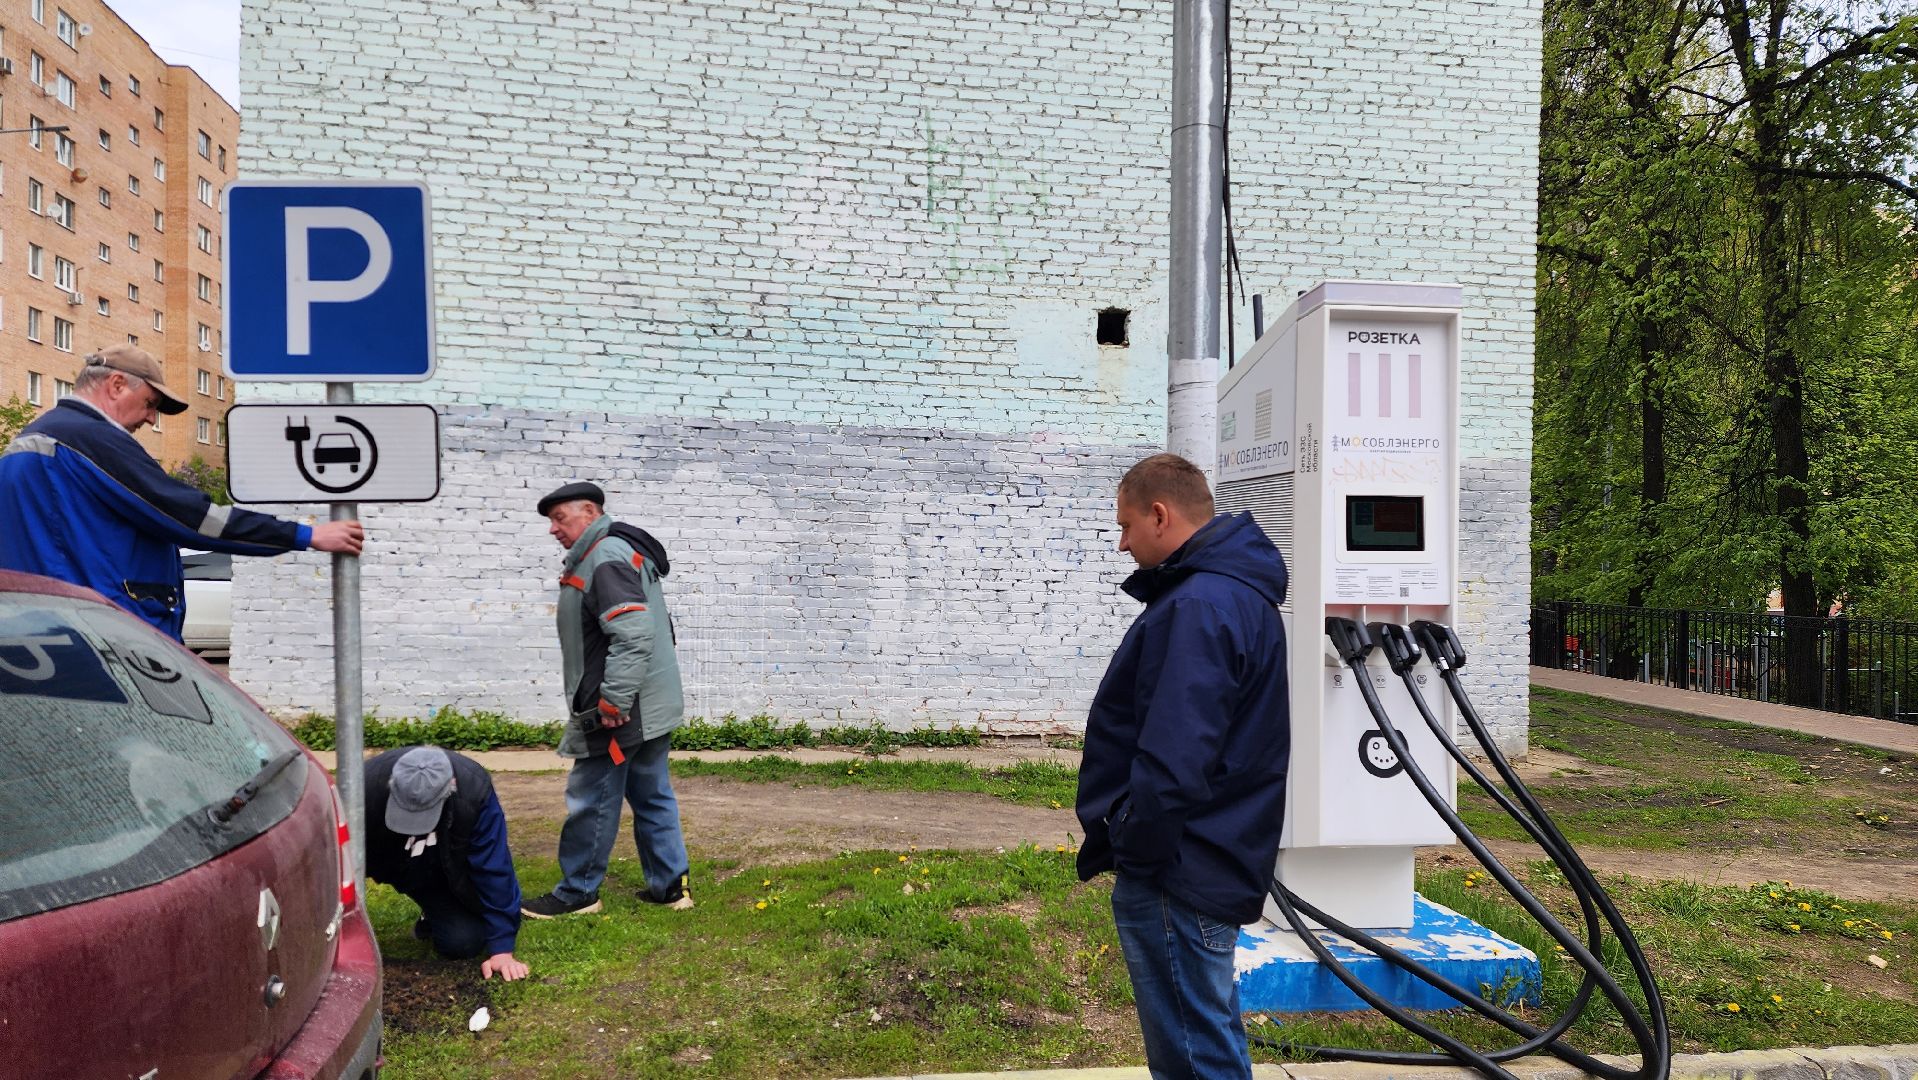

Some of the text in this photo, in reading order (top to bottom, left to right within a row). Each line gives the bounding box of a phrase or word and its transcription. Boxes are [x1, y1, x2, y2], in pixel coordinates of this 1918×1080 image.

[284, 206, 393, 356] P
[1348, 331, 1421, 345] РОЗЕТКА
[1341, 437, 1440, 449] МОСОБЛЭНЕРГО
[1224, 440, 1289, 468] МОСОБЛЭНЕРГО
